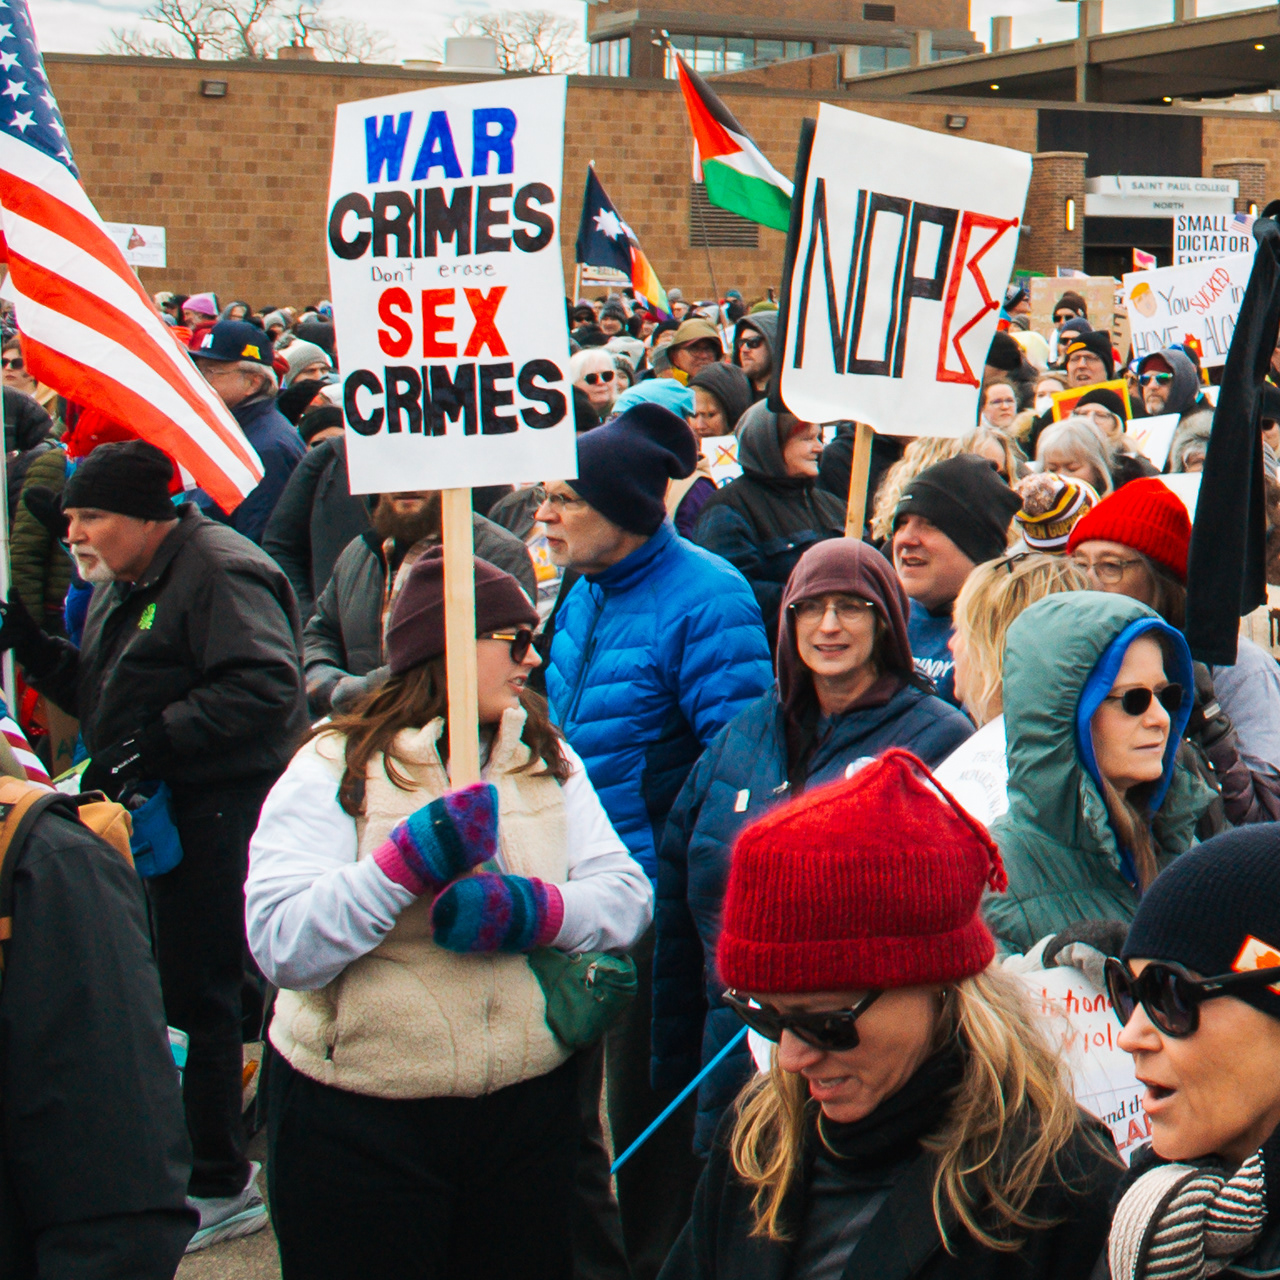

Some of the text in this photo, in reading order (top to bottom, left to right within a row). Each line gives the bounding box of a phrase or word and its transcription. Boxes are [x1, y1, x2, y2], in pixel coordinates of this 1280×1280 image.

[364, 107, 518, 184] WAR
[1131, 181, 1230, 193] SAINT PAUL COLLEGE
[328, 182, 555, 261] CRIMES
[1153, 201, 1185, 210] NORTH
[1177, 214, 1229, 232] SMALL
[1177, 235, 1250, 253] DICTATOR
[371, 261, 497, 283] Don't erase
[1158, 286, 1191, 317] You
[1189, 267, 1230, 315] SUCKED
[377, 285, 510, 358] SEX
[1201, 312, 1238, 358] ALO
[343, 358, 568, 437] CRIMES
[1061, 1022, 1123, 1054] viol
[1129, 1094, 1145, 1116] th
